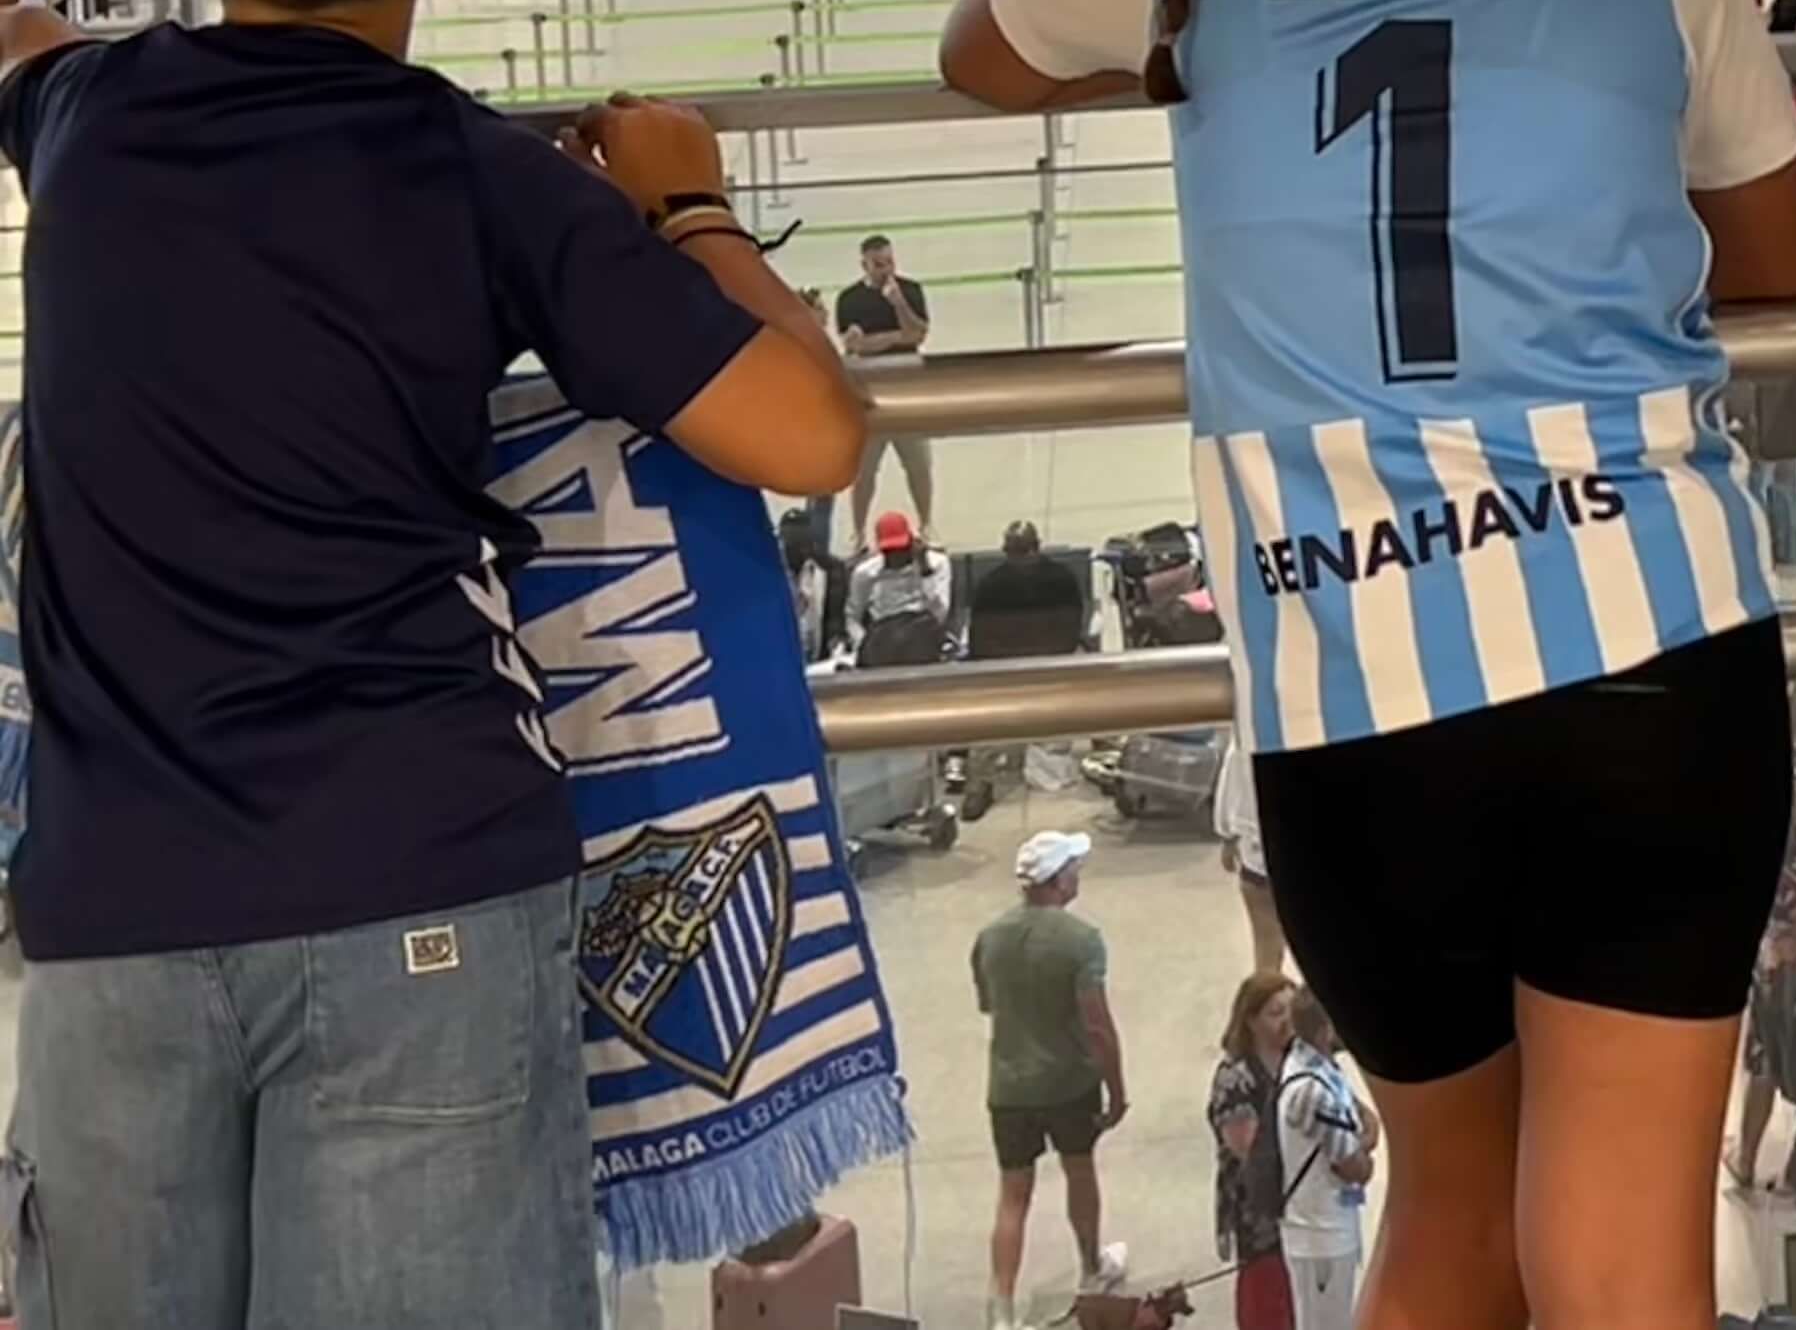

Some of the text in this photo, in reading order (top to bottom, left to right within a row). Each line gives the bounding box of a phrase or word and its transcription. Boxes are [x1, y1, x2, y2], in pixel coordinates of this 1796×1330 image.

[1315, 18, 1458, 386] 1
[1255, 473, 1626, 596] BENAHAVIS
[706, 1104, 772, 1149] CLUB
[772, 1090, 798, 1116] DE
